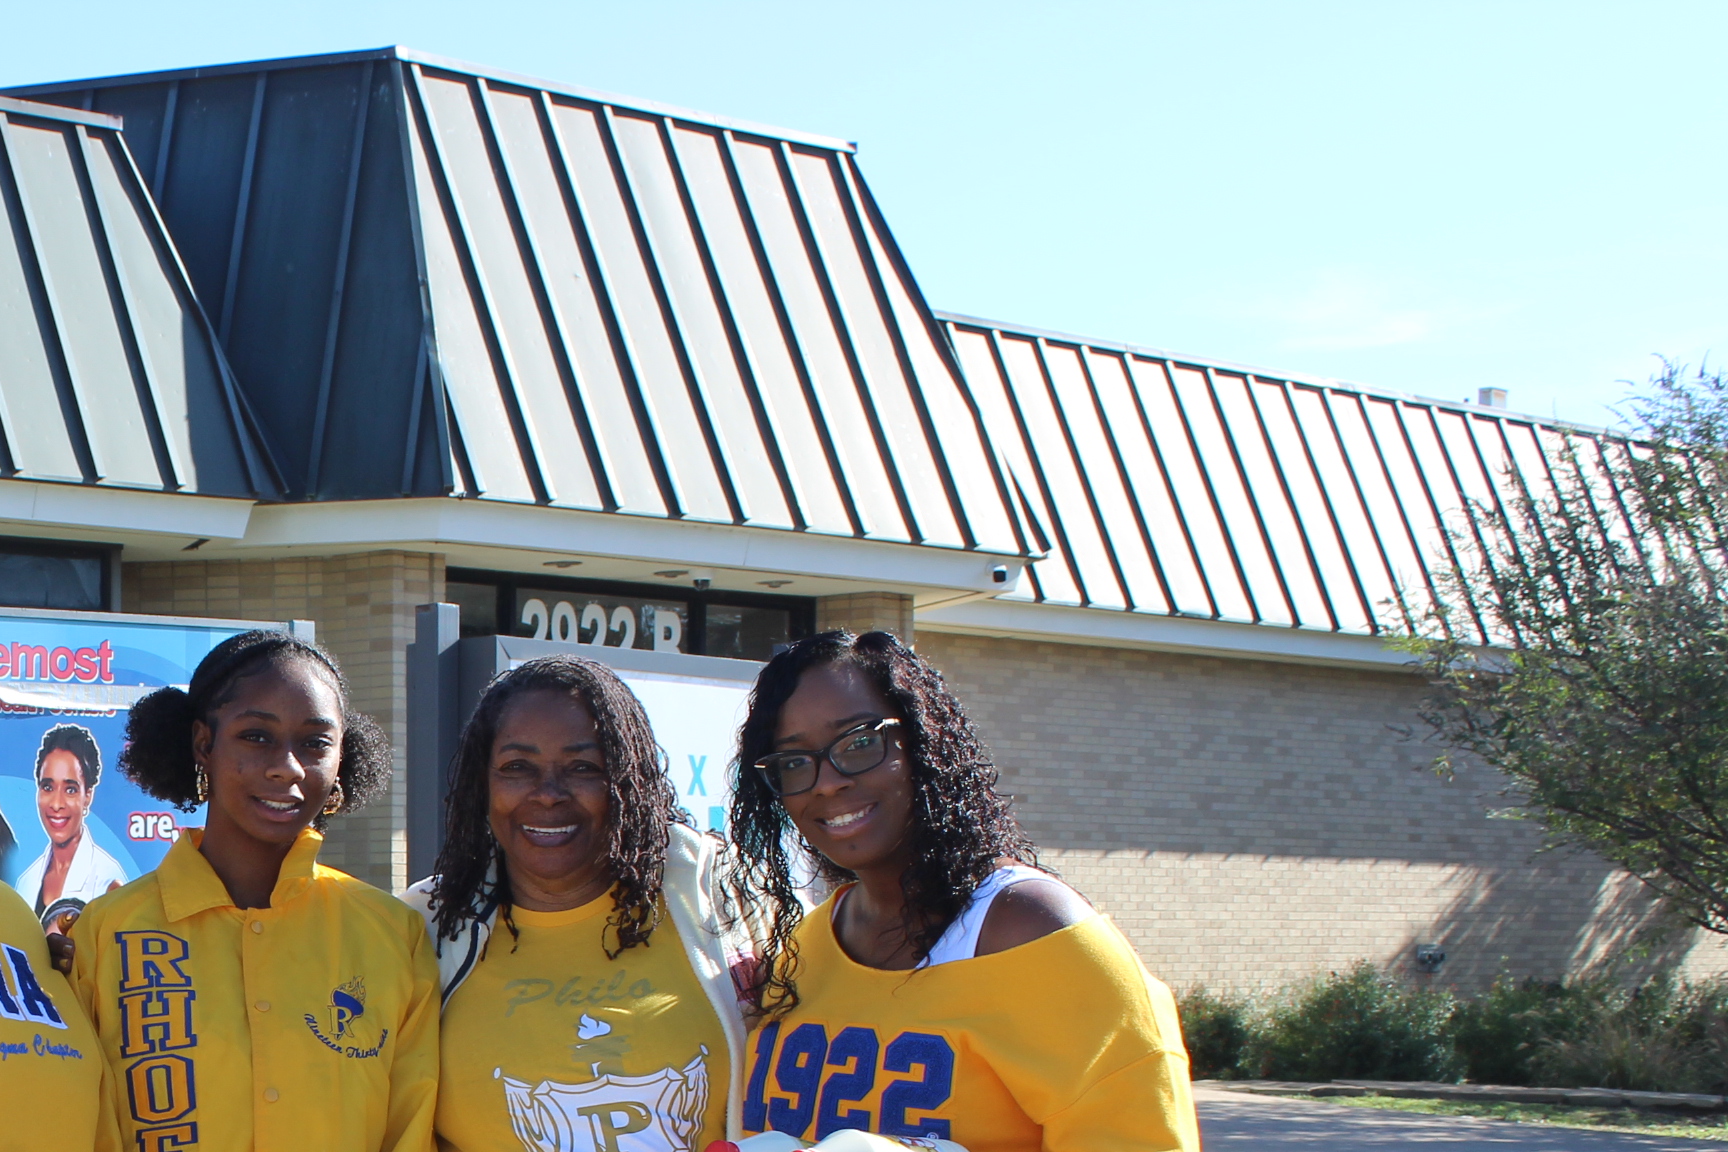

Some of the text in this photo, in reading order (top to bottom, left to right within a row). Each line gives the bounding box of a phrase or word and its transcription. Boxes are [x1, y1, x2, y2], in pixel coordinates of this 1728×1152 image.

[128, 812, 181, 844] are,
[503, 970, 659, 1018] Philo
[304, 1014, 343, 1053] Nineteen
[742, 1021, 955, 1142] 1922
